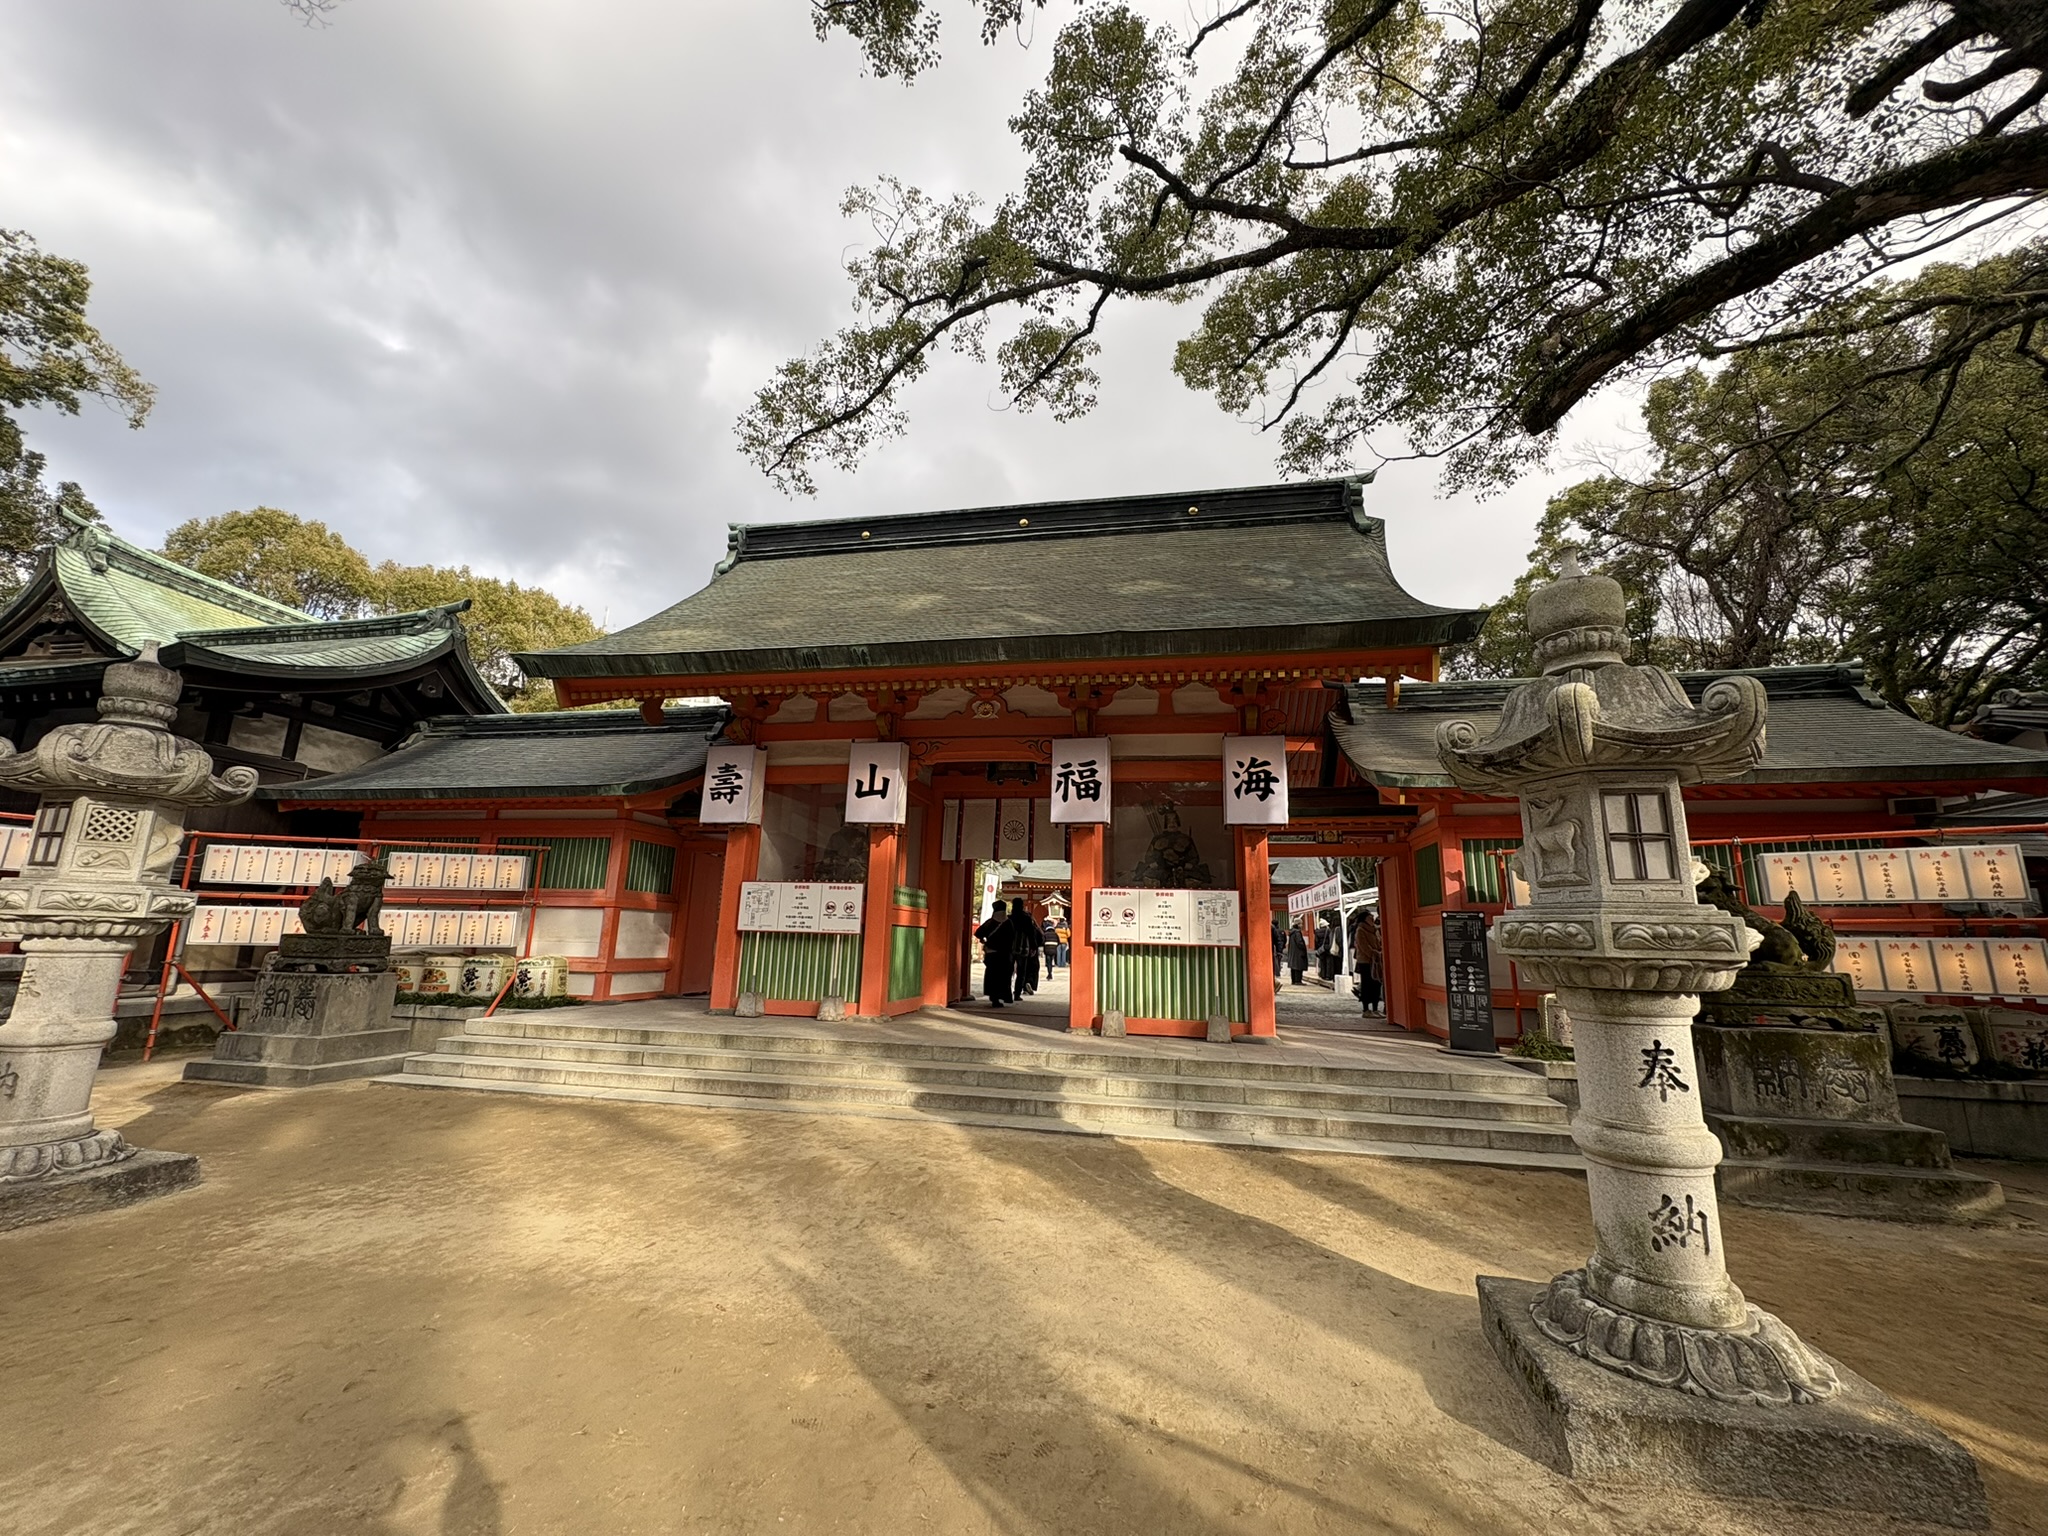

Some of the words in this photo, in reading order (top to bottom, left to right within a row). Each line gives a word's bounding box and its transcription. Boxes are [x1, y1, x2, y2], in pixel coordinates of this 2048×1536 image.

[708, 762, 744, 805] 壽
[855, 763, 890, 800] 山
[1056, 760, 1102, 802] 福
[1232, 757, 1279, 802] 海
